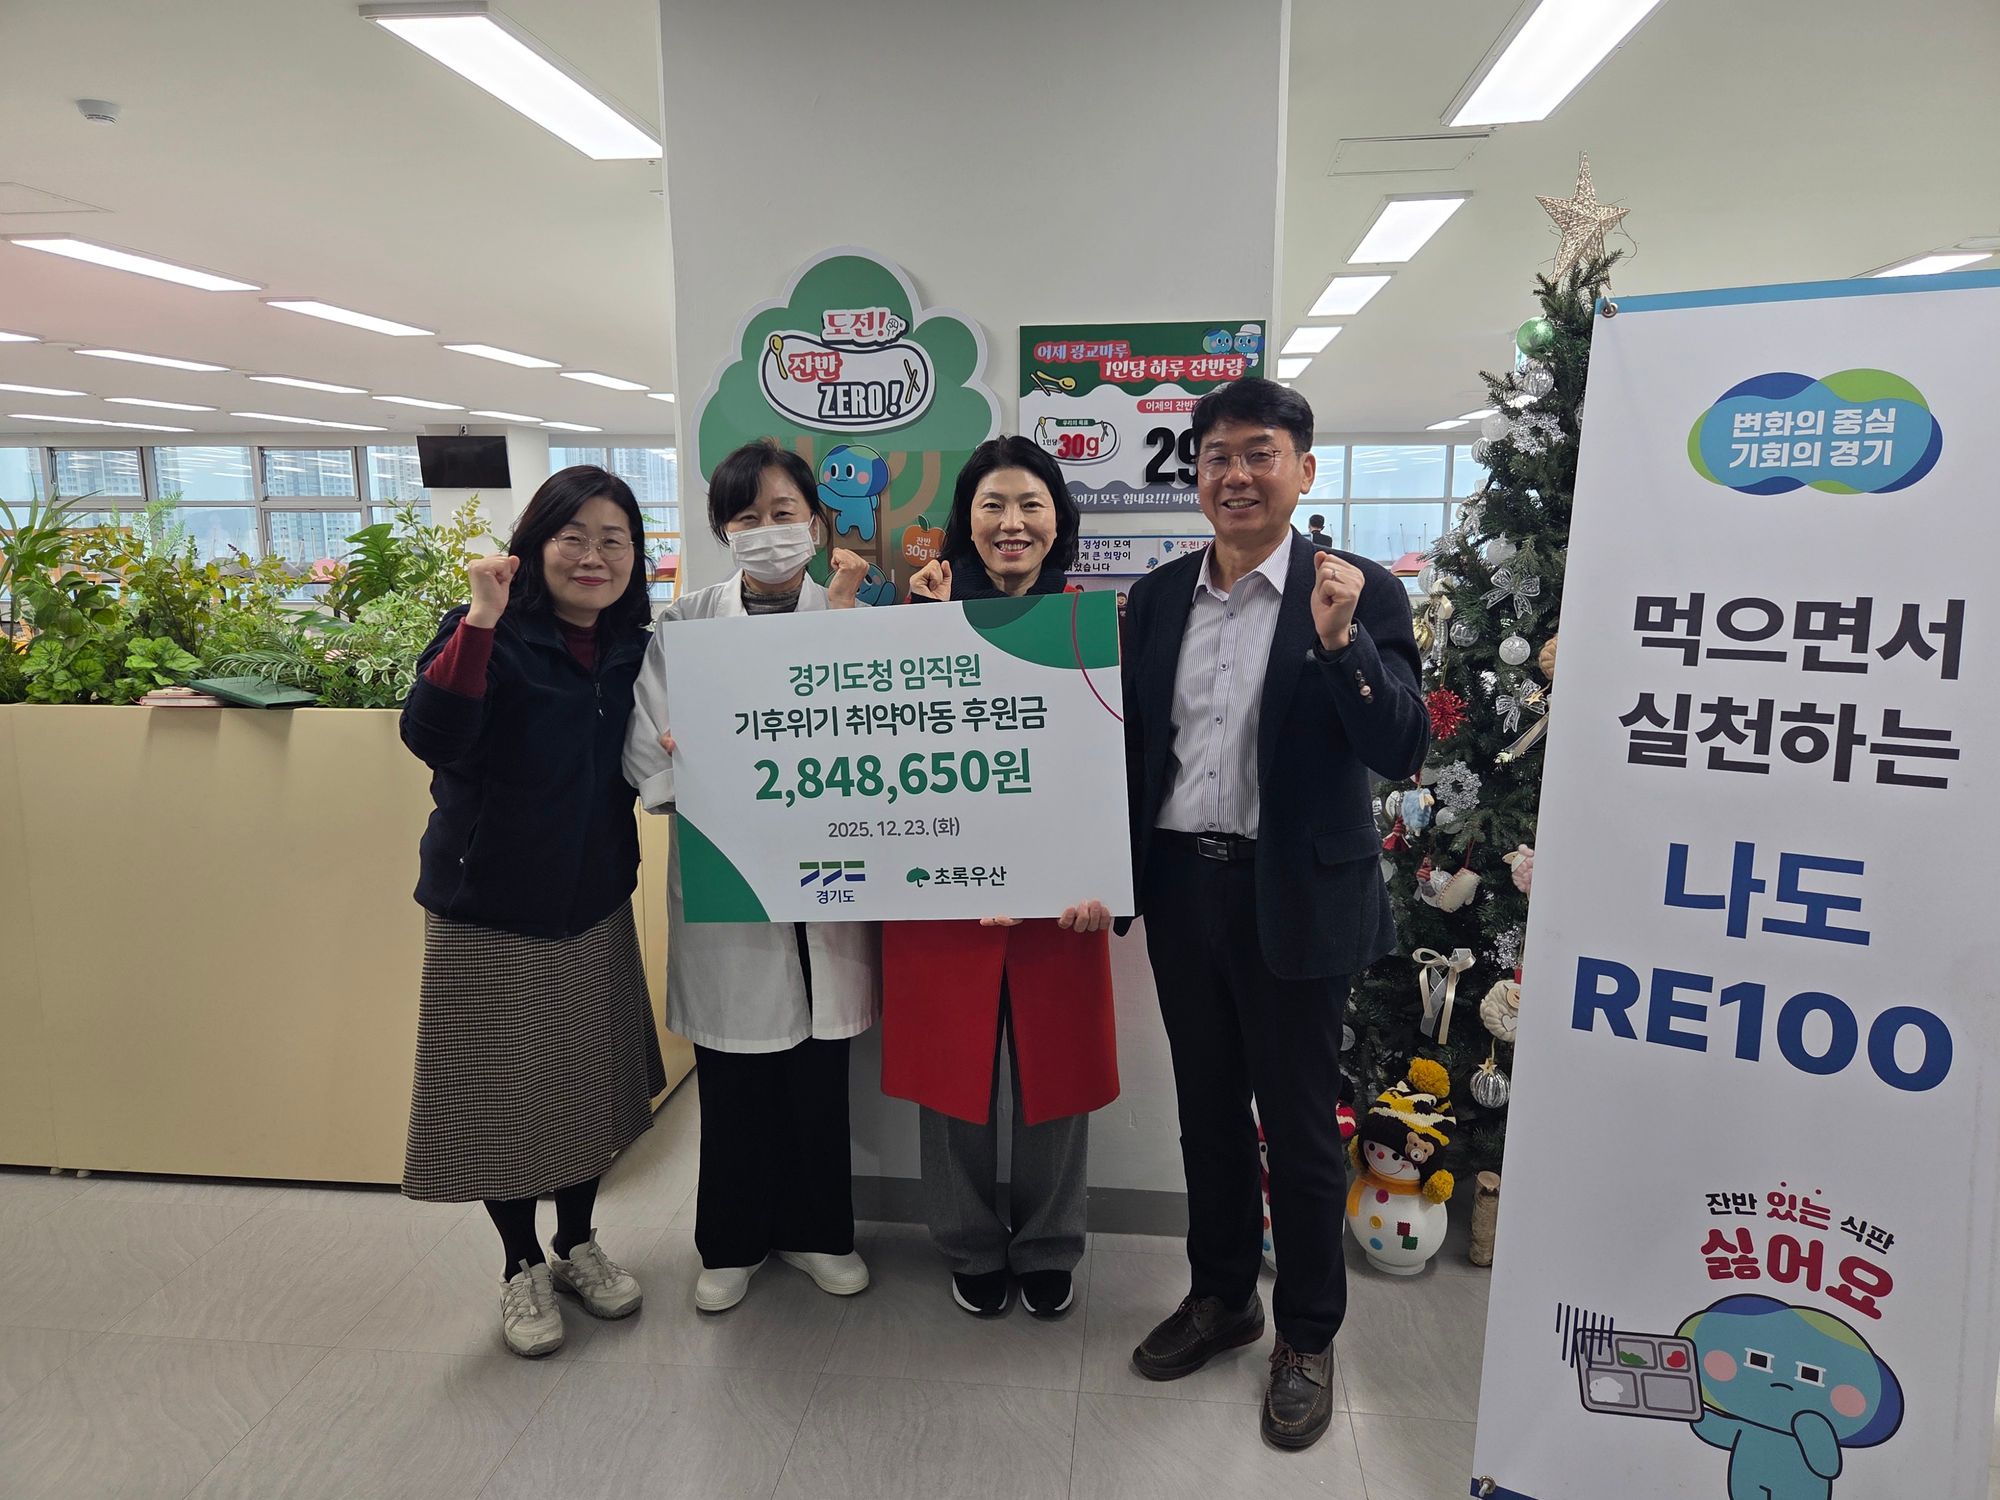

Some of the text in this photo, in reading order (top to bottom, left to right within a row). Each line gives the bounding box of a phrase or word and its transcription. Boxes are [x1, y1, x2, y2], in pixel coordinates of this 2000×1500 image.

[826, 311, 886, 338] 도전!
[1037, 343, 1130, 360] 어제 광교마루
[789, 353, 840, 381] 잔반
[1105, 358, 1246, 379] 1인당 하루 잔반량
[819, 382, 903, 417] ZERO!
[1146, 400, 1197, 411] 어제의 잔반
[1732, 408, 1897, 438] 변화의 중심
[1057, 433, 1099, 458] 30g
[1729, 440, 1893, 468] 기회의 경기
[1100, 493, 1121, 505] 모두
[1123, 493, 1170, 505] 힘내요!!!
[905, 544, 928, 560] 30g
[1083, 540, 1131, 550] 정성이 모여
[1092, 551, 1101, 561] 큰
[1104, 551, 1131, 561] 희망이
[1633, 593, 1965, 680] 먹으면서
[789, 653, 982, 697] 경기도청 임직원
[735, 696, 1048, 742] 기후위기 취약아동 후원금
[1618, 692, 1960, 789] 실천하는
[754, 748, 1032, 808] 2,848,650원
[828, 821, 874, 838] 2025.
[932, 816, 961, 837] (화)
[934, 866, 1007, 887] 초록우산
[816, 889, 856, 904] 경기도
[1664, 841, 1870, 946] 나도
[1572, 956, 1953, 1092] RE100
[1705, 1191, 1895, 1255] 잔반 있는 식판
[1701, 1227, 1893, 1320] 싫어요
